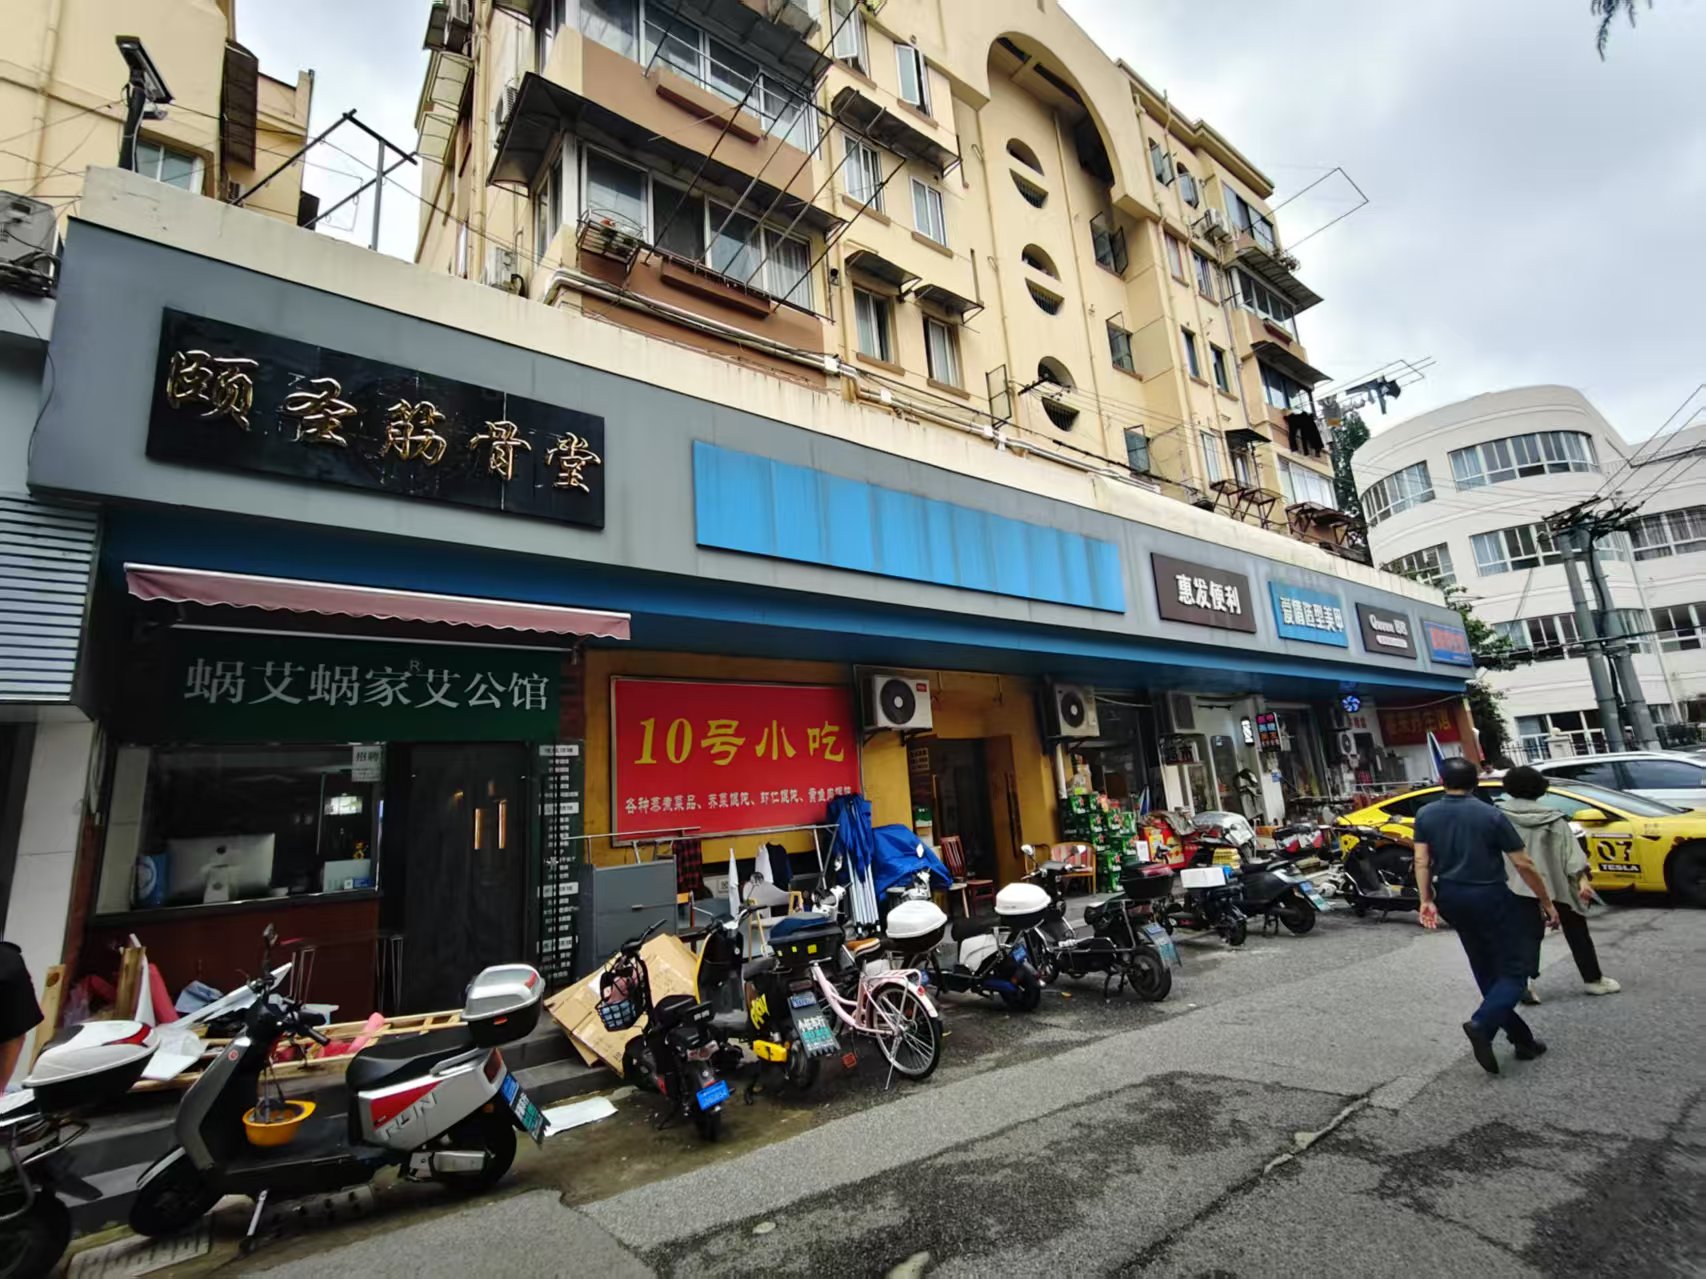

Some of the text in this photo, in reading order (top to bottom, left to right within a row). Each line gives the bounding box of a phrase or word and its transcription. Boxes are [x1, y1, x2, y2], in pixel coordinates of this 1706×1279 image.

[1175, 573, 1242, 615] 惠发便利
[183, 658, 550, 710] 蜗艾蜗家艾公馆
[634, 717, 846, 766] 10号小吃
[1597, 840, 1633, 862] 07
[1600, 864, 1640, 872] TESLA
